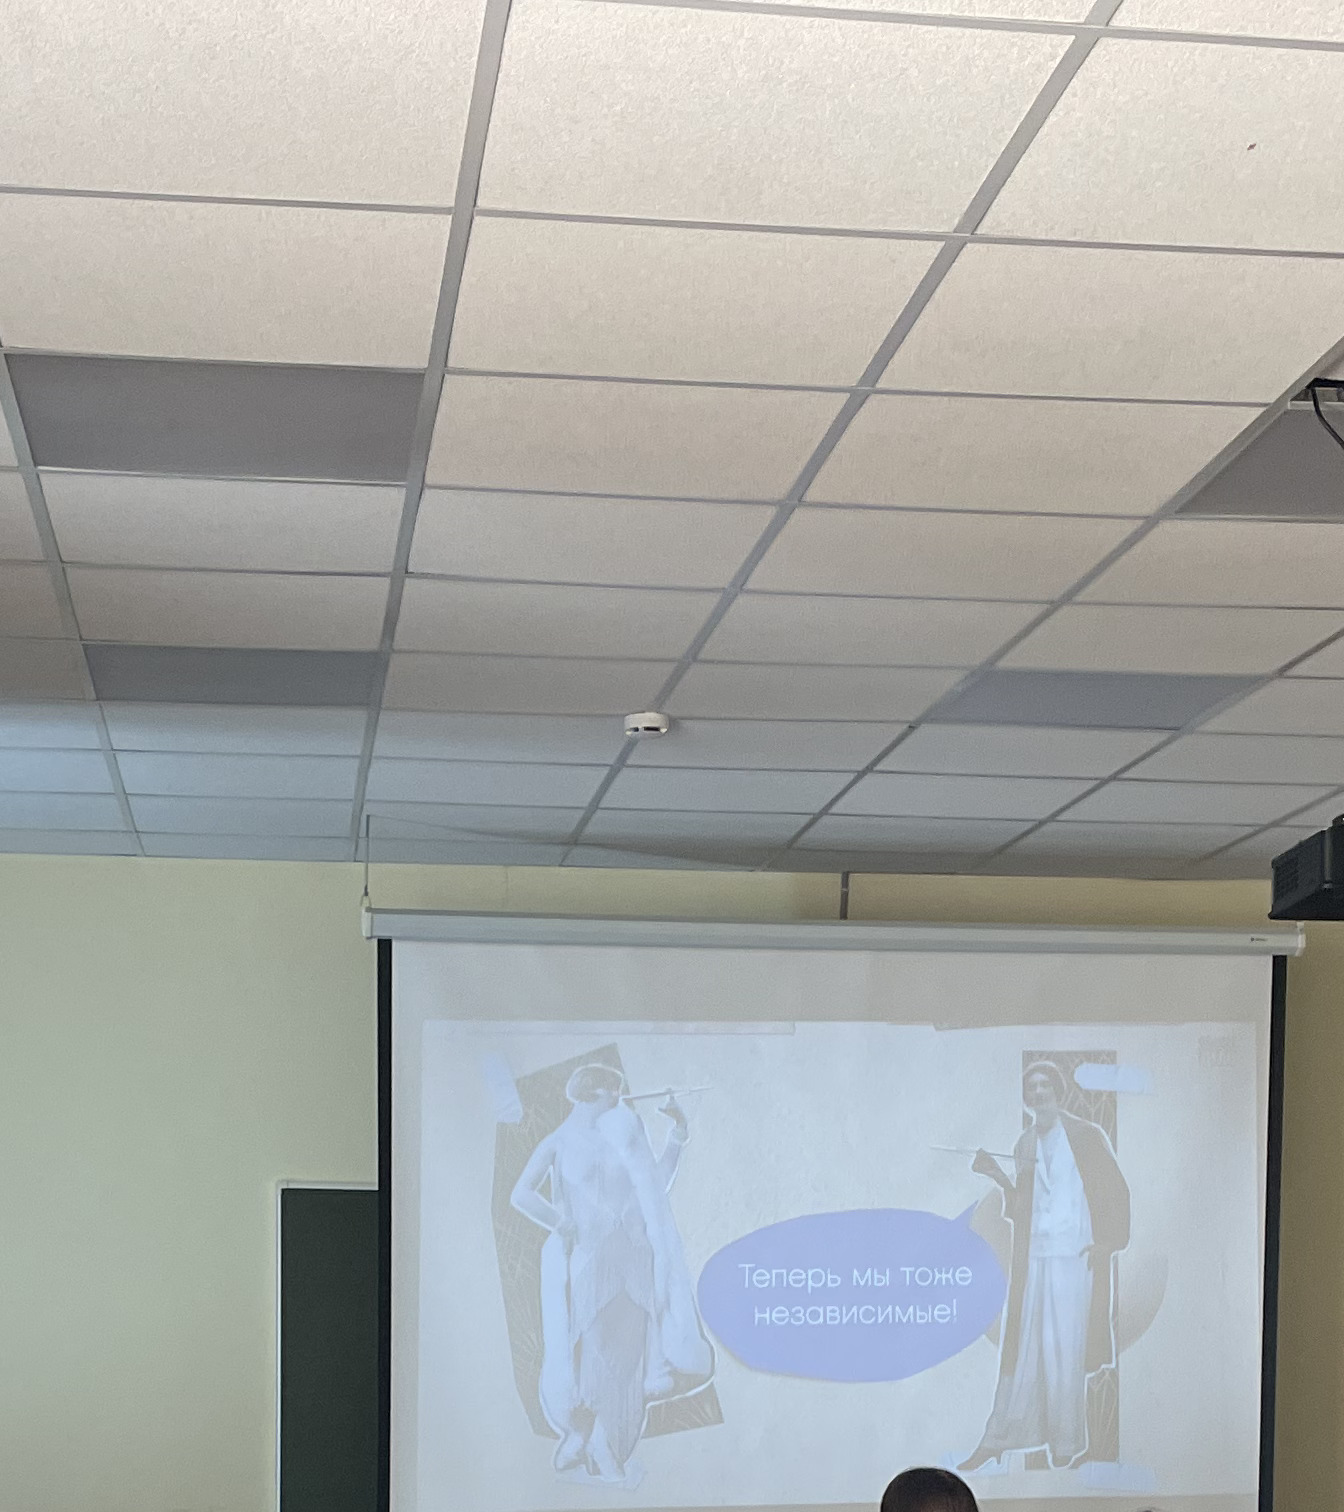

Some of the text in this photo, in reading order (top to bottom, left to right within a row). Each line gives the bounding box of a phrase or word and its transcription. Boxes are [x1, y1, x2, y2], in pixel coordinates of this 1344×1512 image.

[738, 1263, 973, 1294] Теперь мы тоже
[754, 1298, 957, 1326] независимые!
